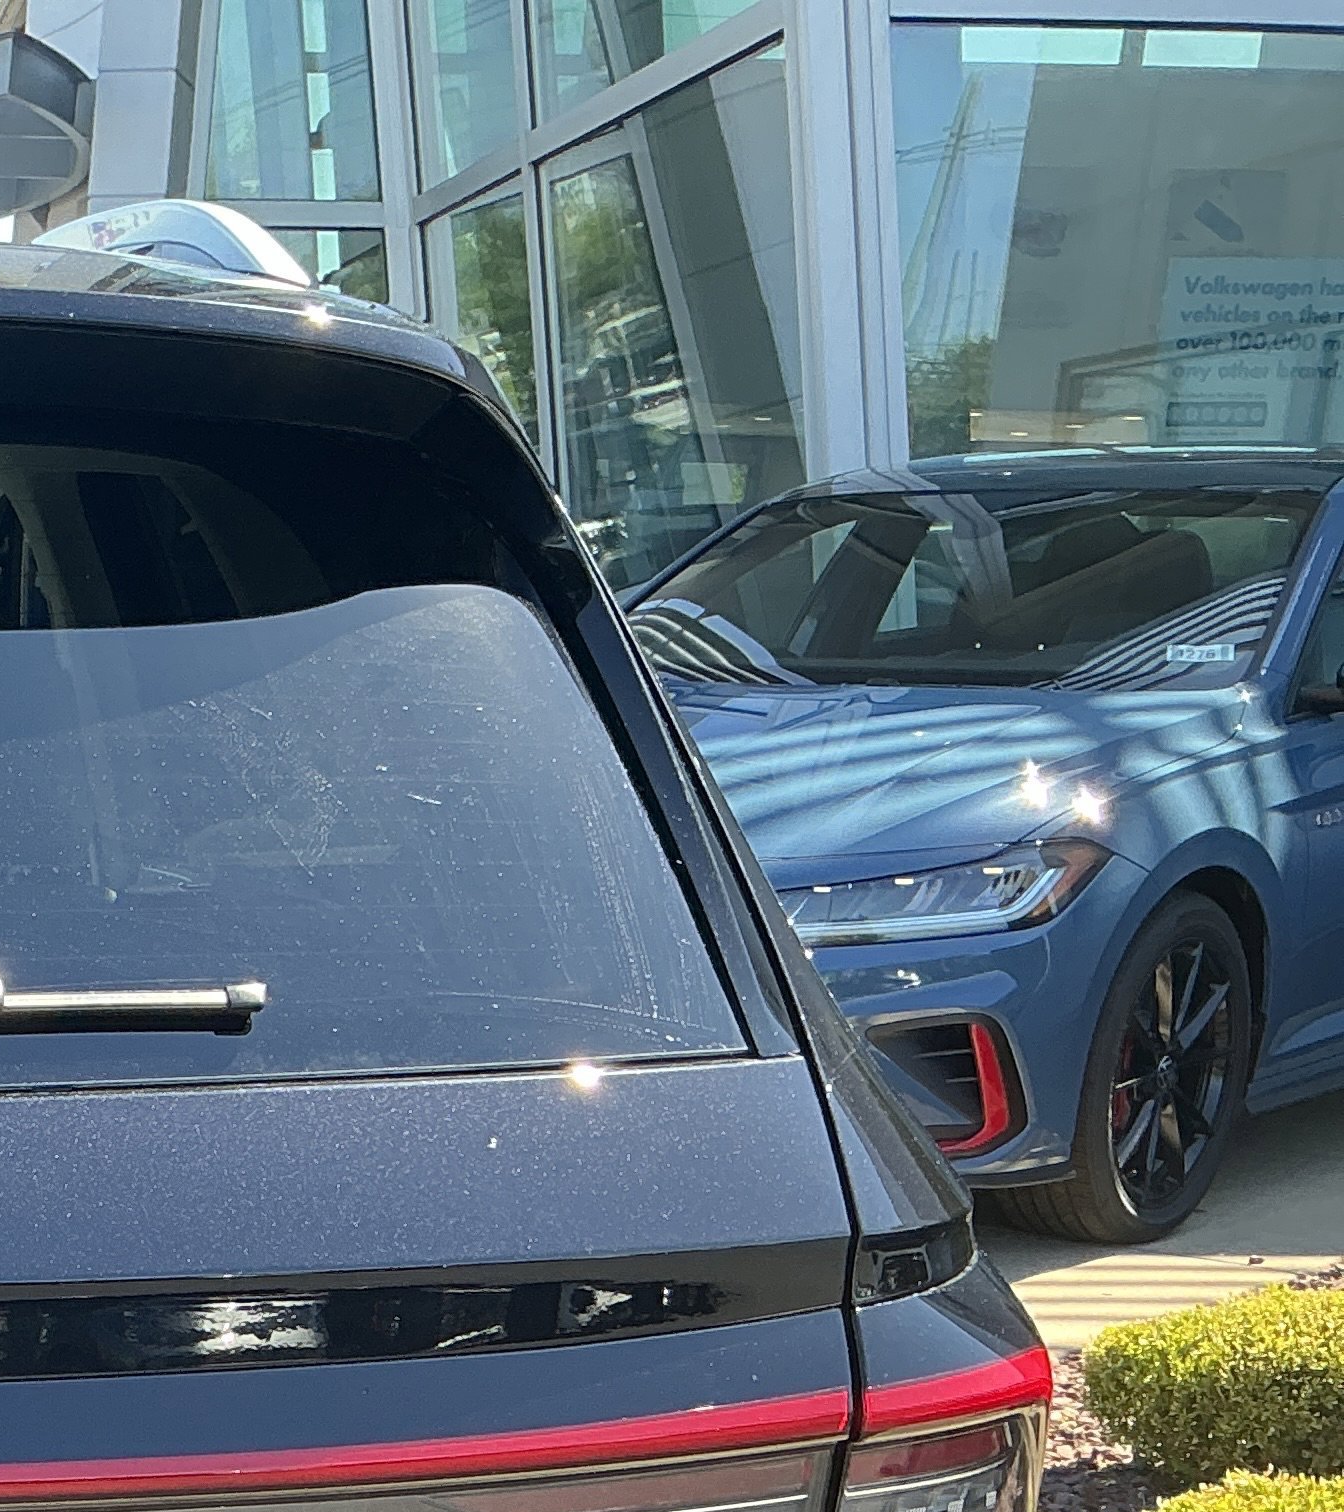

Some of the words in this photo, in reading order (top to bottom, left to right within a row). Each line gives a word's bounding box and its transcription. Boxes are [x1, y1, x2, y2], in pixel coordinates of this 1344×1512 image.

[1184, 275, 1313, 300] Volkswagen
[1181, 304, 1261, 323] vehicles
[1267, 310, 1294, 323] on
[1299, 304, 1331, 324] the
[1176, 336, 1223, 350] over
[1172, 364, 1211, 382] any
